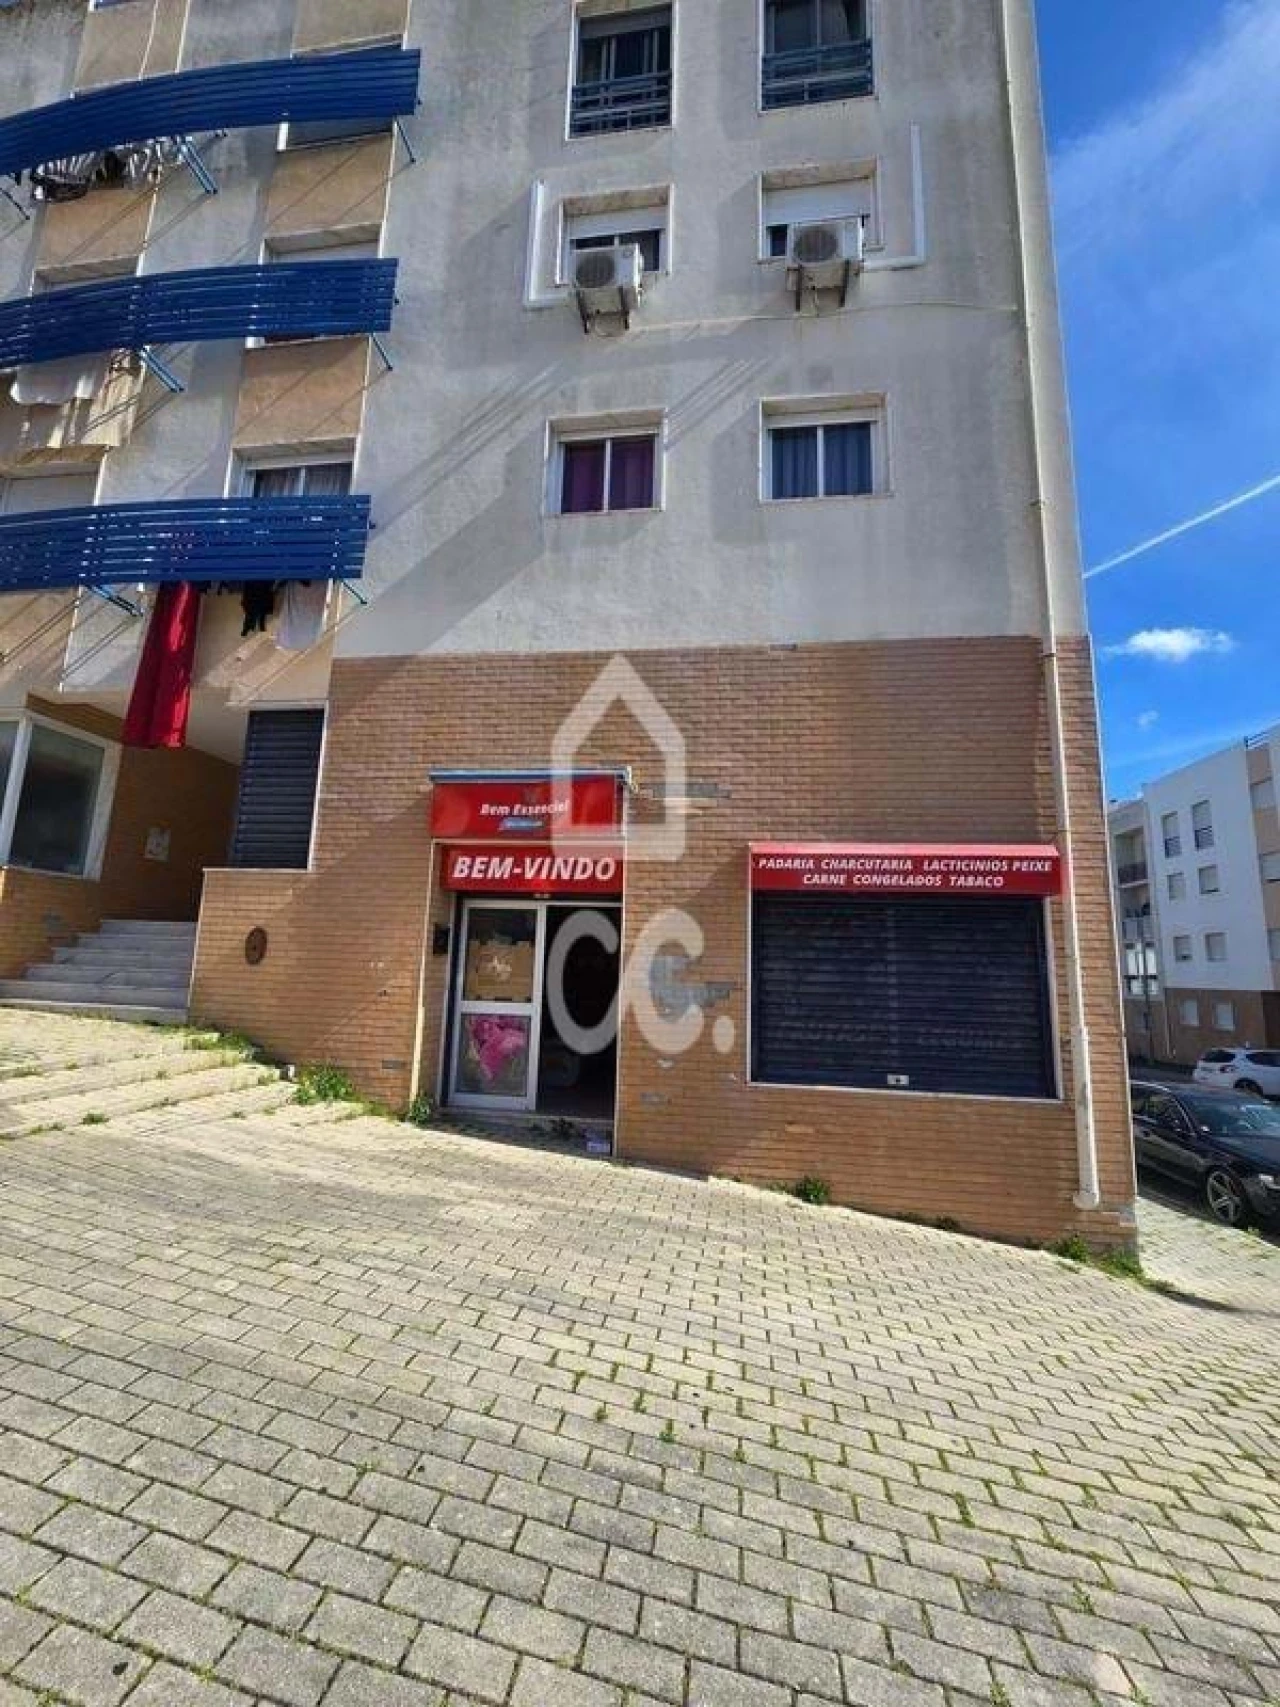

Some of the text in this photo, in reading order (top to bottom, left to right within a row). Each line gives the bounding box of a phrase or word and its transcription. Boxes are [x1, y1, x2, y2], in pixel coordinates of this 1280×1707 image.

[453, 855, 616, 880] BEM-VINDO
[758, 858, 815, 869] PADARIA
[821, 859, 913, 870] CHARCUTARIA
[1013, 860, 1053, 872] PEIXE
[803, 874, 1004, 887] CARNE CONGELADOS TABACO
